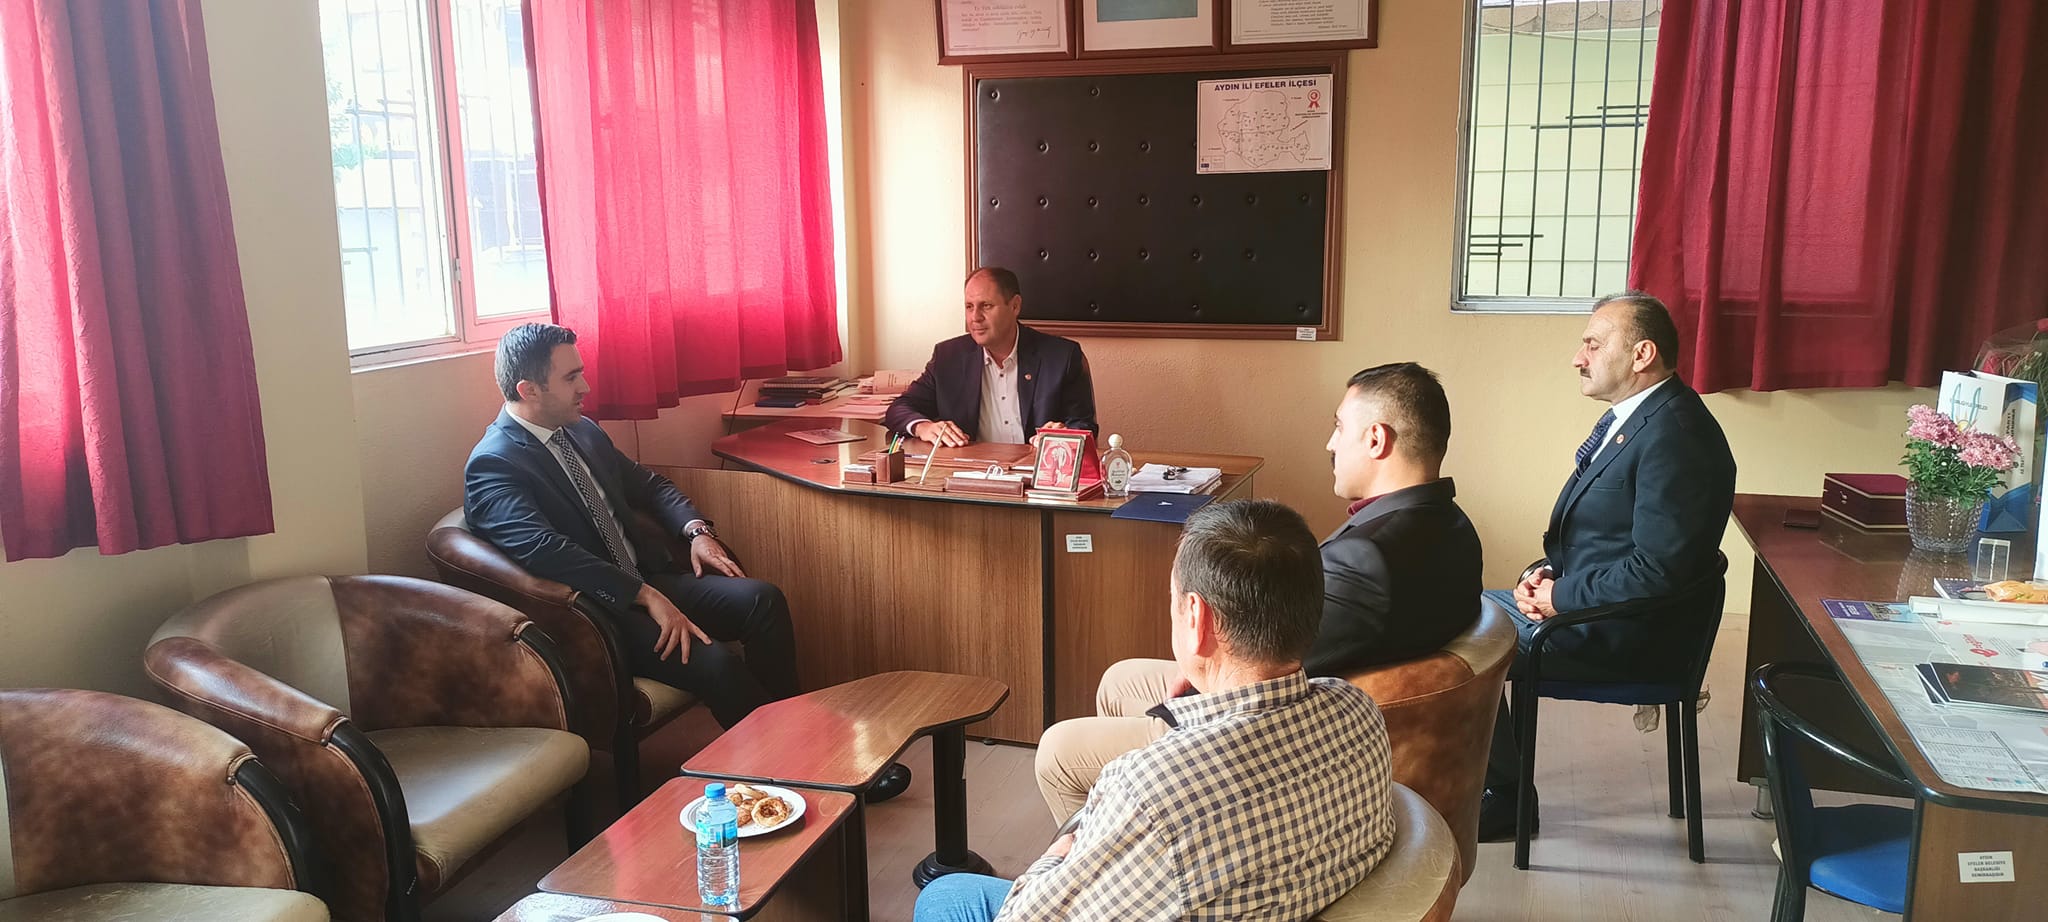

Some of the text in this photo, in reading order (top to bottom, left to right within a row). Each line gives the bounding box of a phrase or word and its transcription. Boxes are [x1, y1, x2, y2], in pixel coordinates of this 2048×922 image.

[1214, 79, 1317, 91] AYDIN İLİ EFELER İLÇESİ
